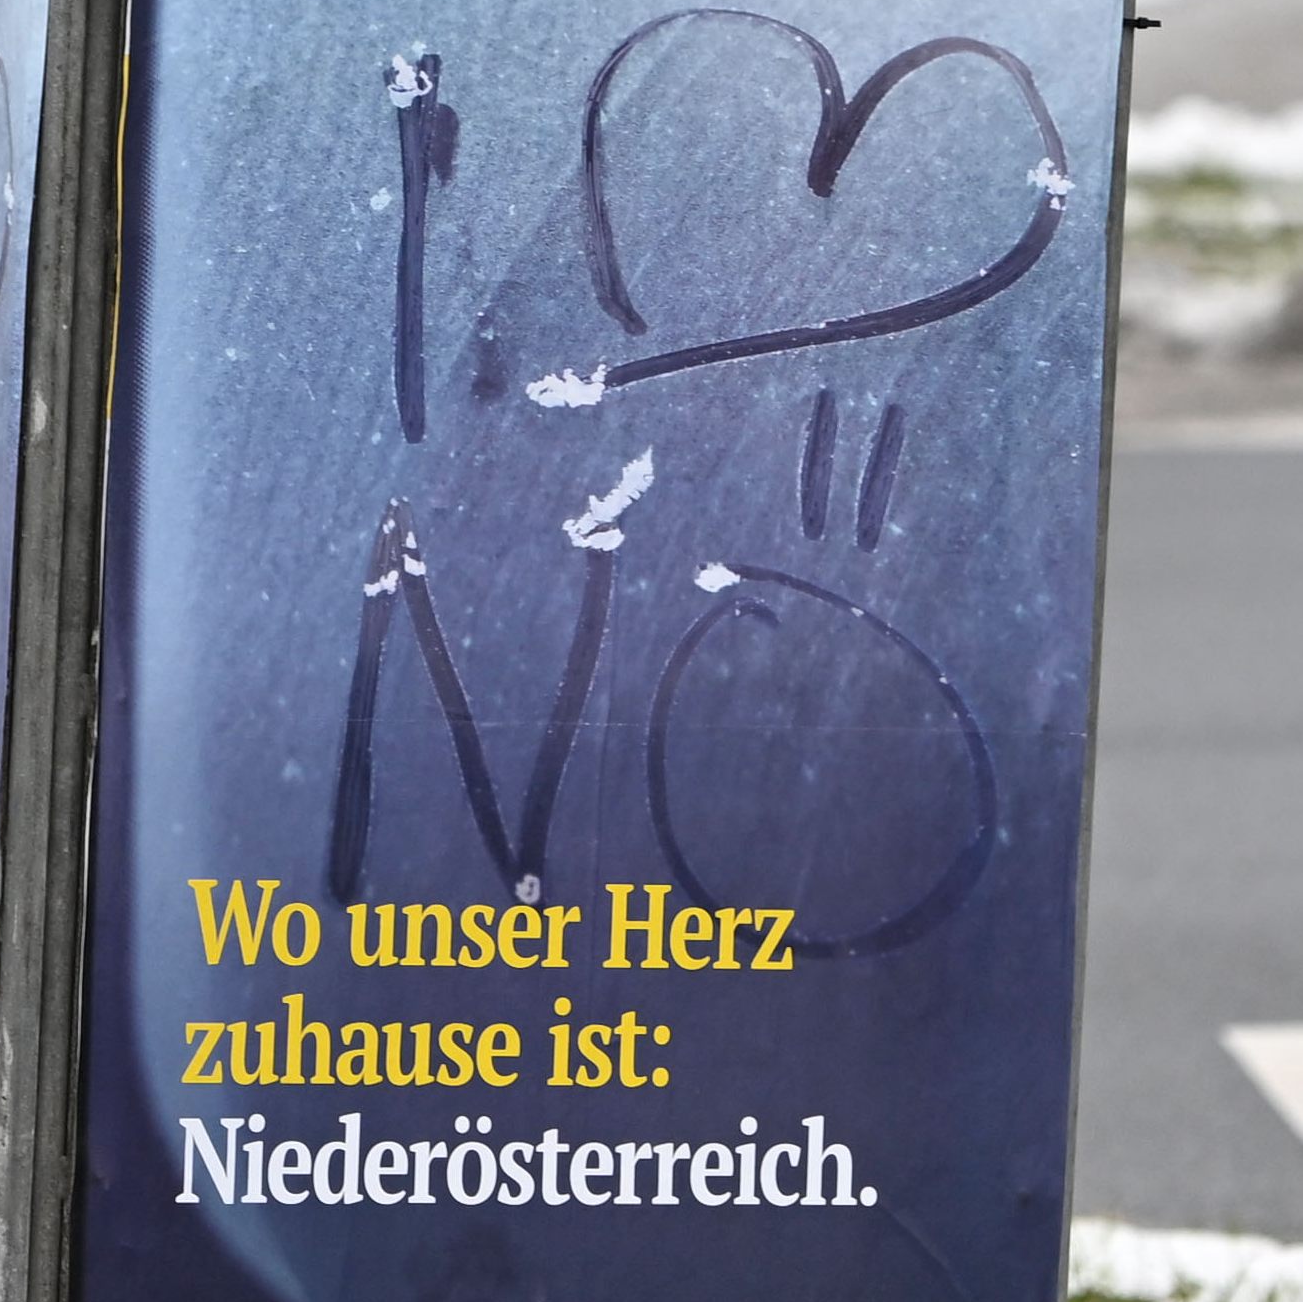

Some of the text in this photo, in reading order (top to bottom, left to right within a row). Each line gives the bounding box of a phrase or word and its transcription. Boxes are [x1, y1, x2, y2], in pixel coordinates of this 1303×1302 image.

[188, 879, 795, 971] Wo unser Herz
[180, 993, 672, 1088] zuhause ist:
[175, 1112, 879, 1207] Niederösterreich.
